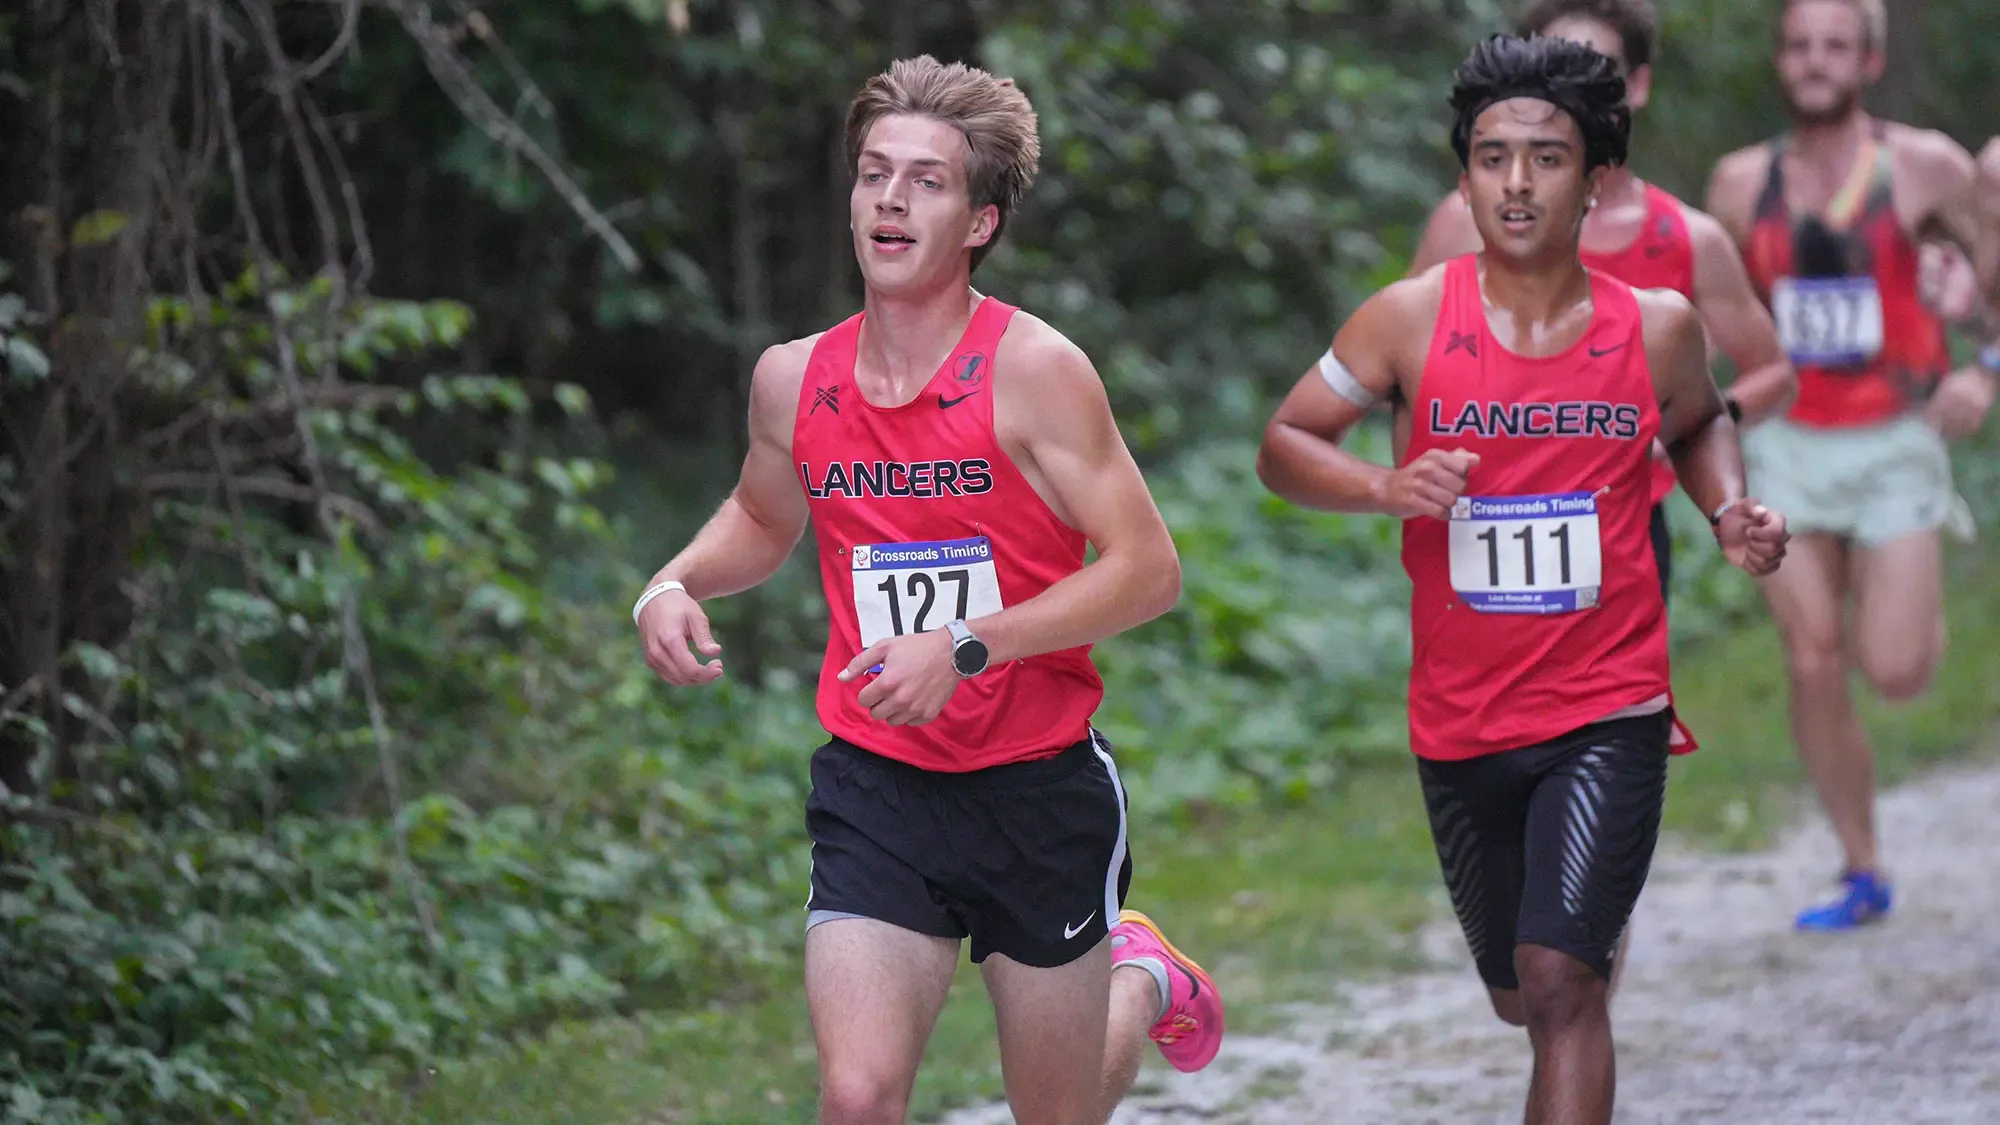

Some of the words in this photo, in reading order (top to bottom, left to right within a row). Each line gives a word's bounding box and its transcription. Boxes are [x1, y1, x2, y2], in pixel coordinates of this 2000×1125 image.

[1430, 399, 1640, 440] LANCERS
[802, 458, 994, 499] LANCERS
[1472, 500, 1548, 515] Crossroads
[1550, 497, 1595, 512] Timing
[872, 548, 939, 563] Crossroads
[941, 544, 989, 559] Timing
[1477, 522, 1570, 586] 111
[877, 569, 970, 636] 127
